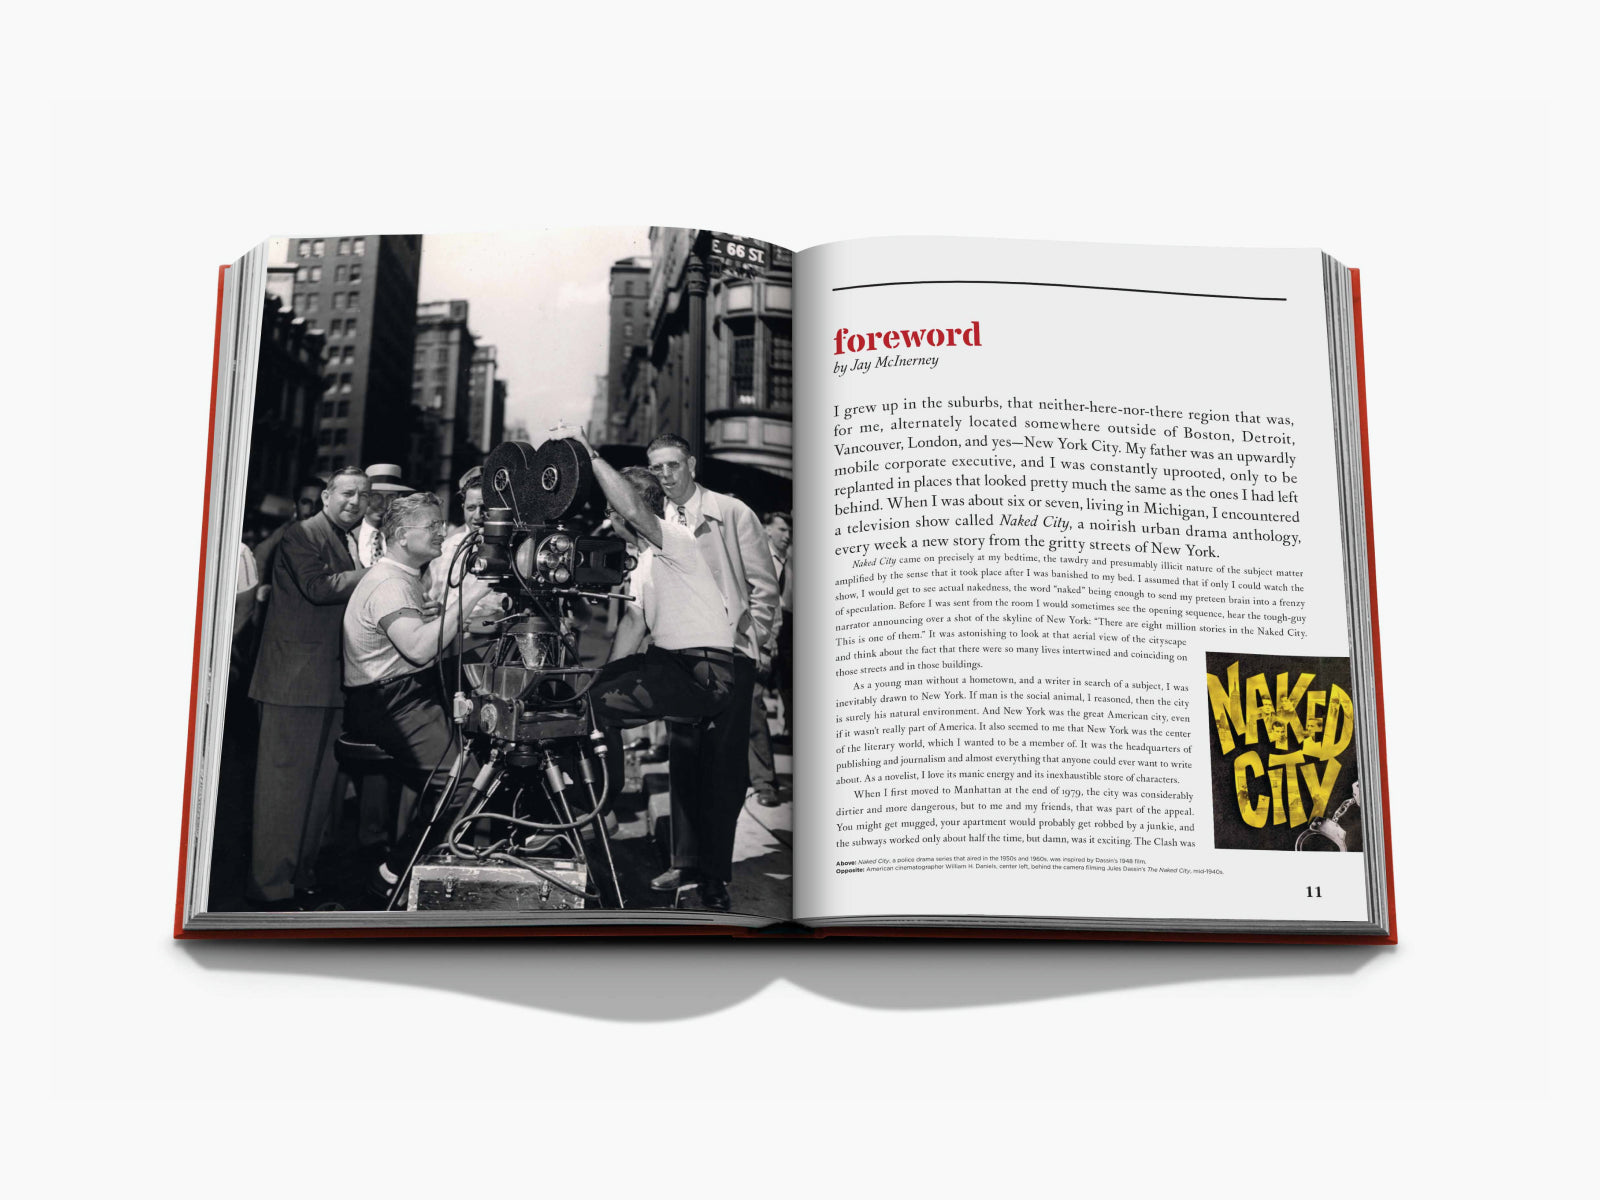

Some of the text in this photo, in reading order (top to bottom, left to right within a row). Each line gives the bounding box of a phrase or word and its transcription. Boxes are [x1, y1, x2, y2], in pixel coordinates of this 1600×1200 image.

[712, 239, 722, 254] E
[726, 242, 746, 258] 66
[834, 320, 982, 356] foreword
[833, 354, 940, 377] by Jay McInerney
[833, 395, 1294, 427] I grew up in the suburbs, that neither-here-nor-there region that was,
[833, 414, 1295, 446] for me, alternately located somewhere outside of Boston, Detroit,
[833, 434, 1296, 469] Vancouver, London, and yes—New York City. My father was an upwardly
[834, 454, 1298, 486] mobile corporate executive, and I was constantly uprooted, only to be
[834, 473, 1298, 503] replanted in places that looked pretty much the same as the ones I had left
[834, 493, 1300, 523] behind. When I was about six or seven, living in Michigan, I encountered
[834, 513, 1302, 547] a television show called Naked City, a noirish urban drama anthology,
[834, 533, 1220, 558] every week a new story from the gritty streets of New York.
[834, 606, 845, 616] of
[845, 602, 897, 617] speculation.
[898, 599, 926, 609] Before
[927, 598, 932, 608] I
[972, 598, 993, 607] from
[995, 597, 1009, 606] the
[1036, 598, 1040, 608] I
[1042, 599, 1069, 609] would
[1070, 602, 1115, 611] sometimes
[1132, 604, 1146, 613] the
[1148, 606, 1183, 618] opening
[1184, 610, 1225, 620] sequence,
[1226, 609, 1246, 619] hear
[1247, 611, 1261, 620] the
[1263, 612, 1307, 625] tough-guy
[835, 659, 983, 677] those streets and in those buildings.
[1206, 660, 1354, 761] NAKED
[1234, 750, 1342, 828] CITY
[1306, 886, 1322, 898] 11
